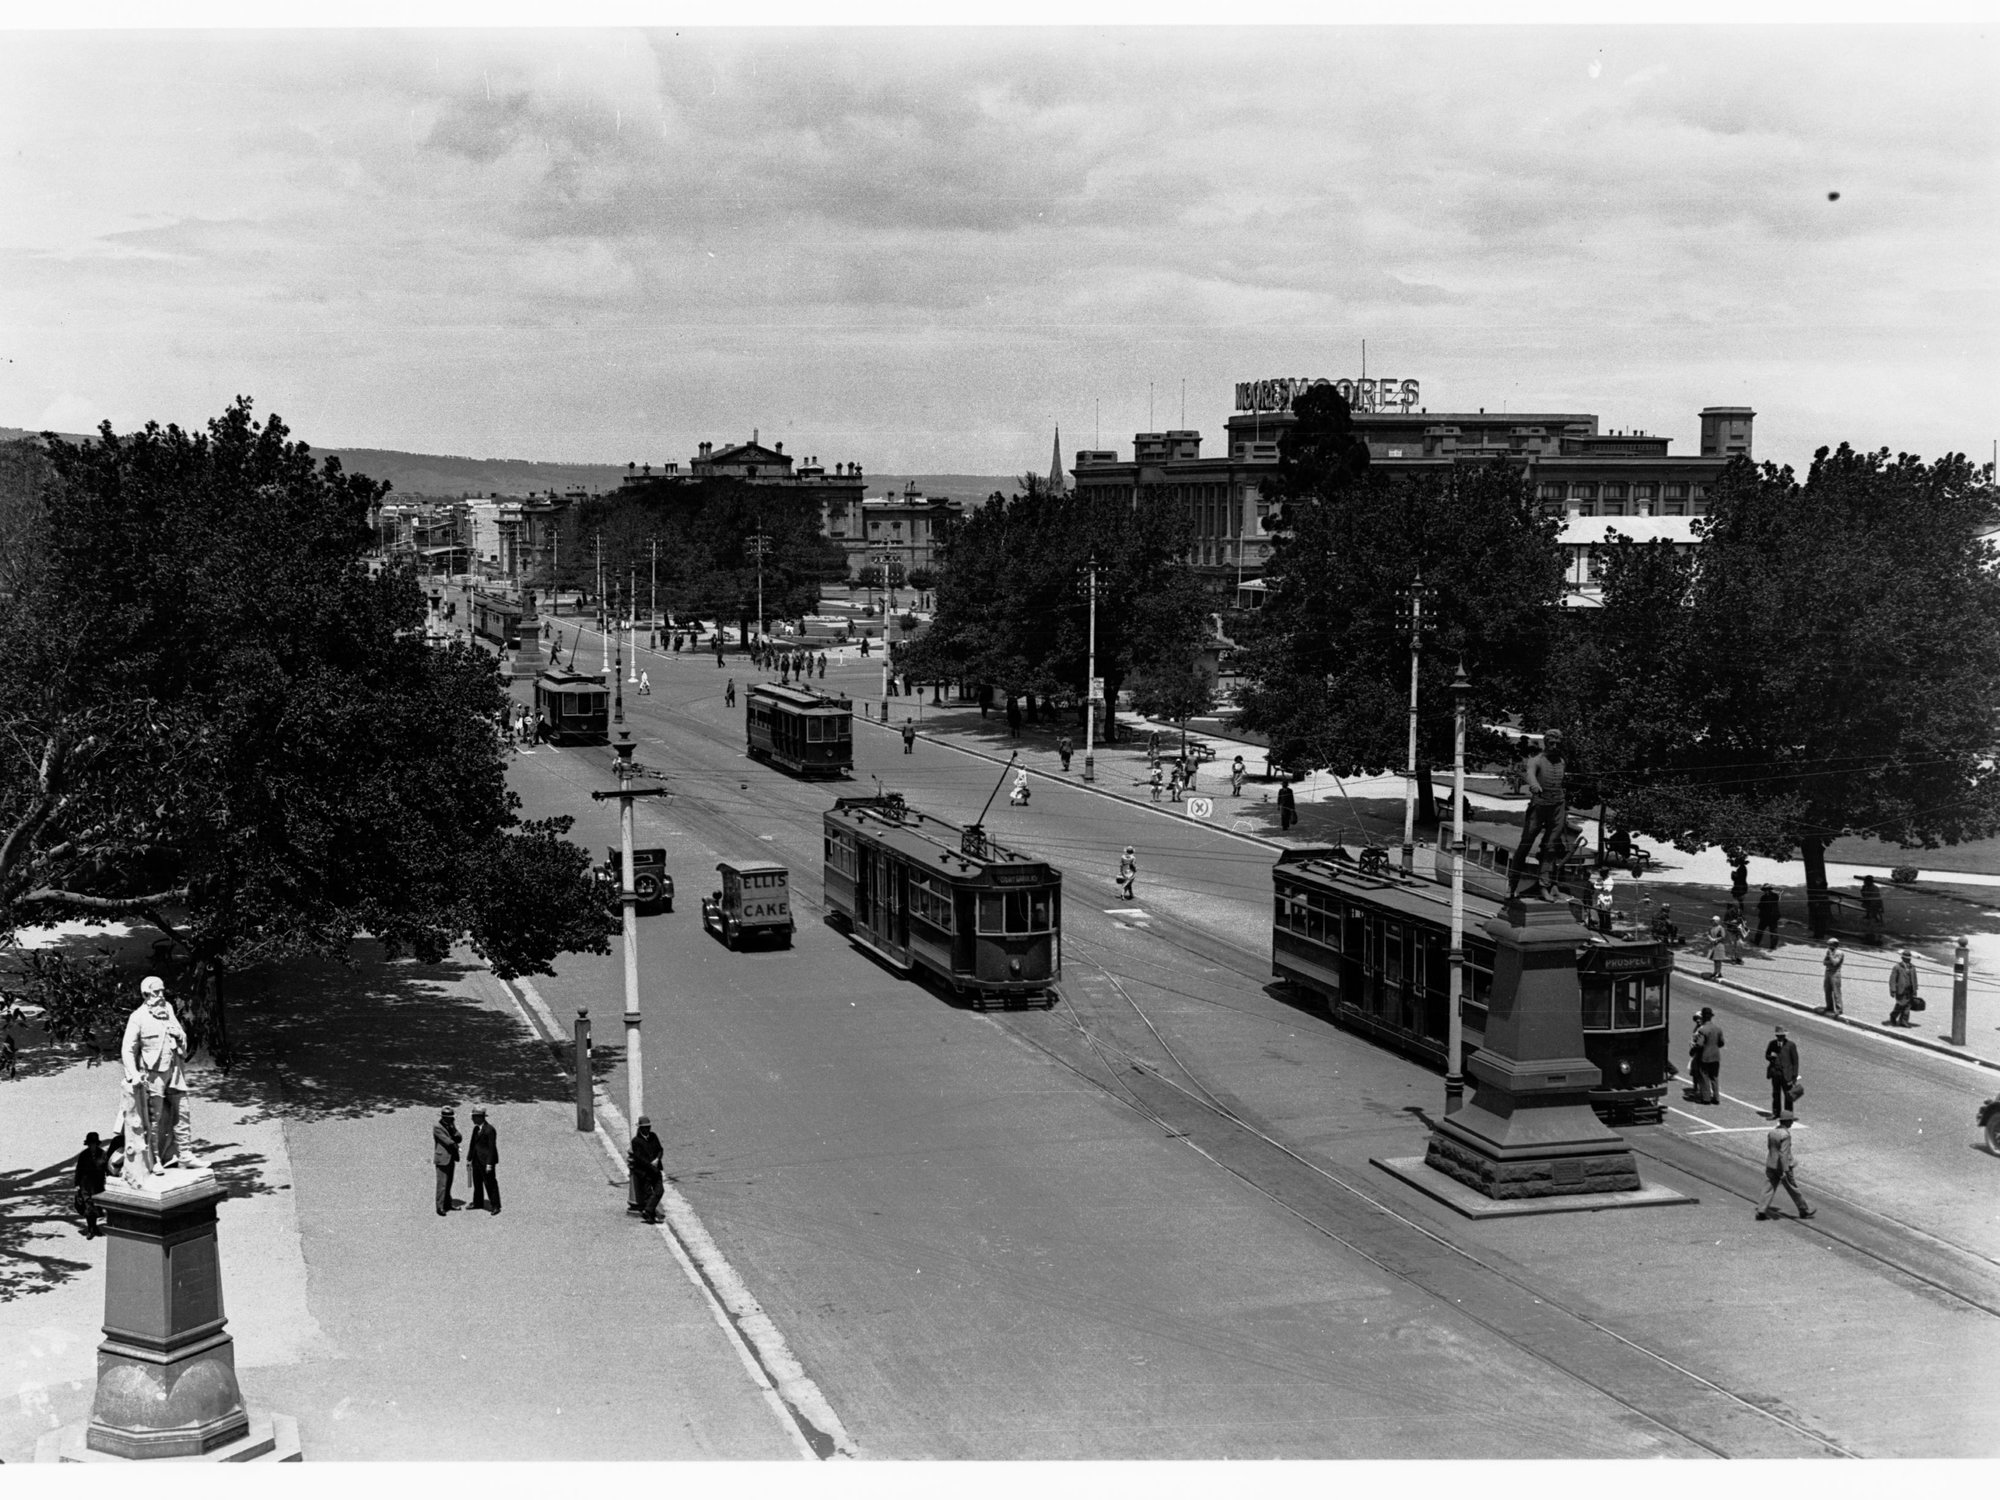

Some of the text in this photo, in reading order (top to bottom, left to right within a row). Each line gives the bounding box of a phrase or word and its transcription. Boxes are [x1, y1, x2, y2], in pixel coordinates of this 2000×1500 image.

[1235, 377, 1289, 411] MOORES
[743, 874, 786, 889] ELLIS
[743, 902, 788, 917] CAKE
